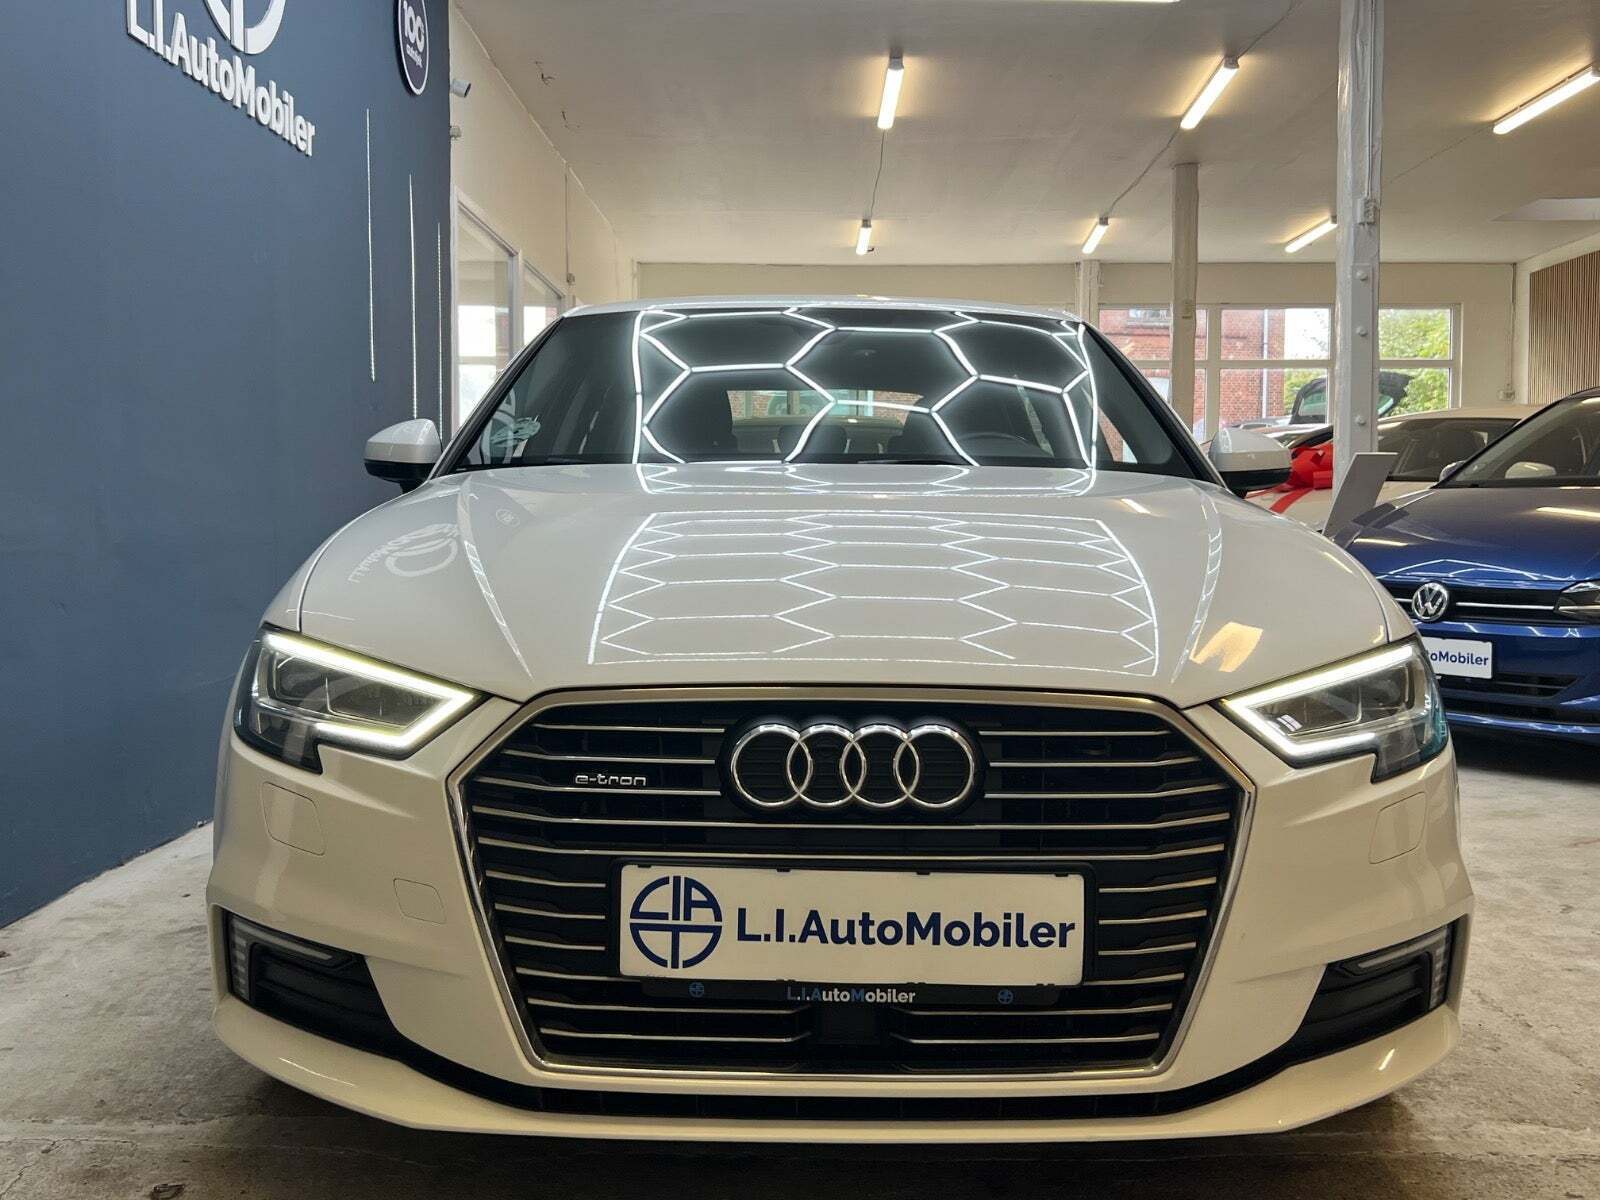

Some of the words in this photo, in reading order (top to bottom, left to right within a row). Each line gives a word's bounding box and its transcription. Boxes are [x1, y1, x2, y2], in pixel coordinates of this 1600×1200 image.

[1427, 650, 1489, 666] oMobiler
[575, 773, 647, 786] e-tron
[737, 907, 1076, 948] L.I.AutoMobiler
[787, 986, 916, 1003] L.I.AutoMobiler
